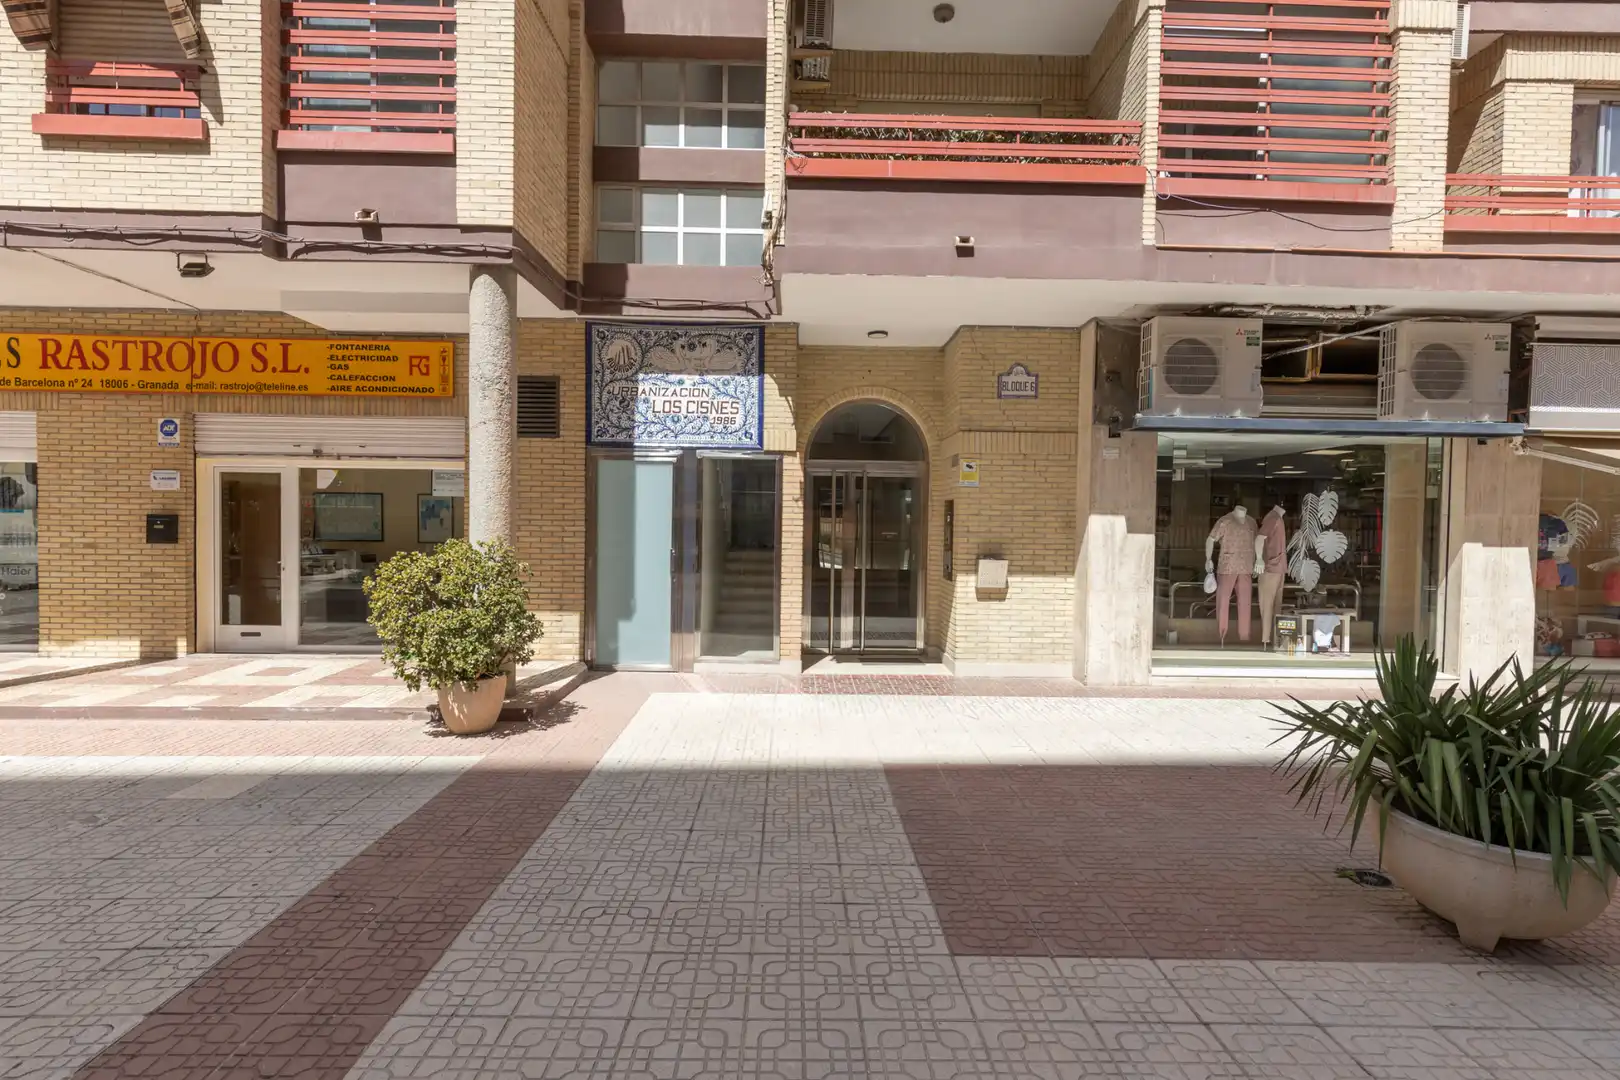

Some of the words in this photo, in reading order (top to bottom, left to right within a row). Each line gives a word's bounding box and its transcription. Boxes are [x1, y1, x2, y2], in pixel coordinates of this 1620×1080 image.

[0, 336, 21, 369] S
[38, 337, 240, 379] RASTROJO
[251, 341, 310, 374] S.L.
[14, 377, 65, 388] Barcelona
[82, 379, 93, 388] 24
[100, 379, 129, 389] 18006
[137, 379, 180, 390] Granada
[219, 381, 309, 393] rastrojo@teleline.es
[355, 385, 435, 394] ACONDICIONADO
[1001, 381, 1029, 392] BLOQUE
[1030, 381, 1035, 392] 6
[652, 400, 682, 414] LOS
[686, 400, 740, 415] CISNES
[710, 416, 737, 425] 1986
[1, 566, 32, 577] Haier
